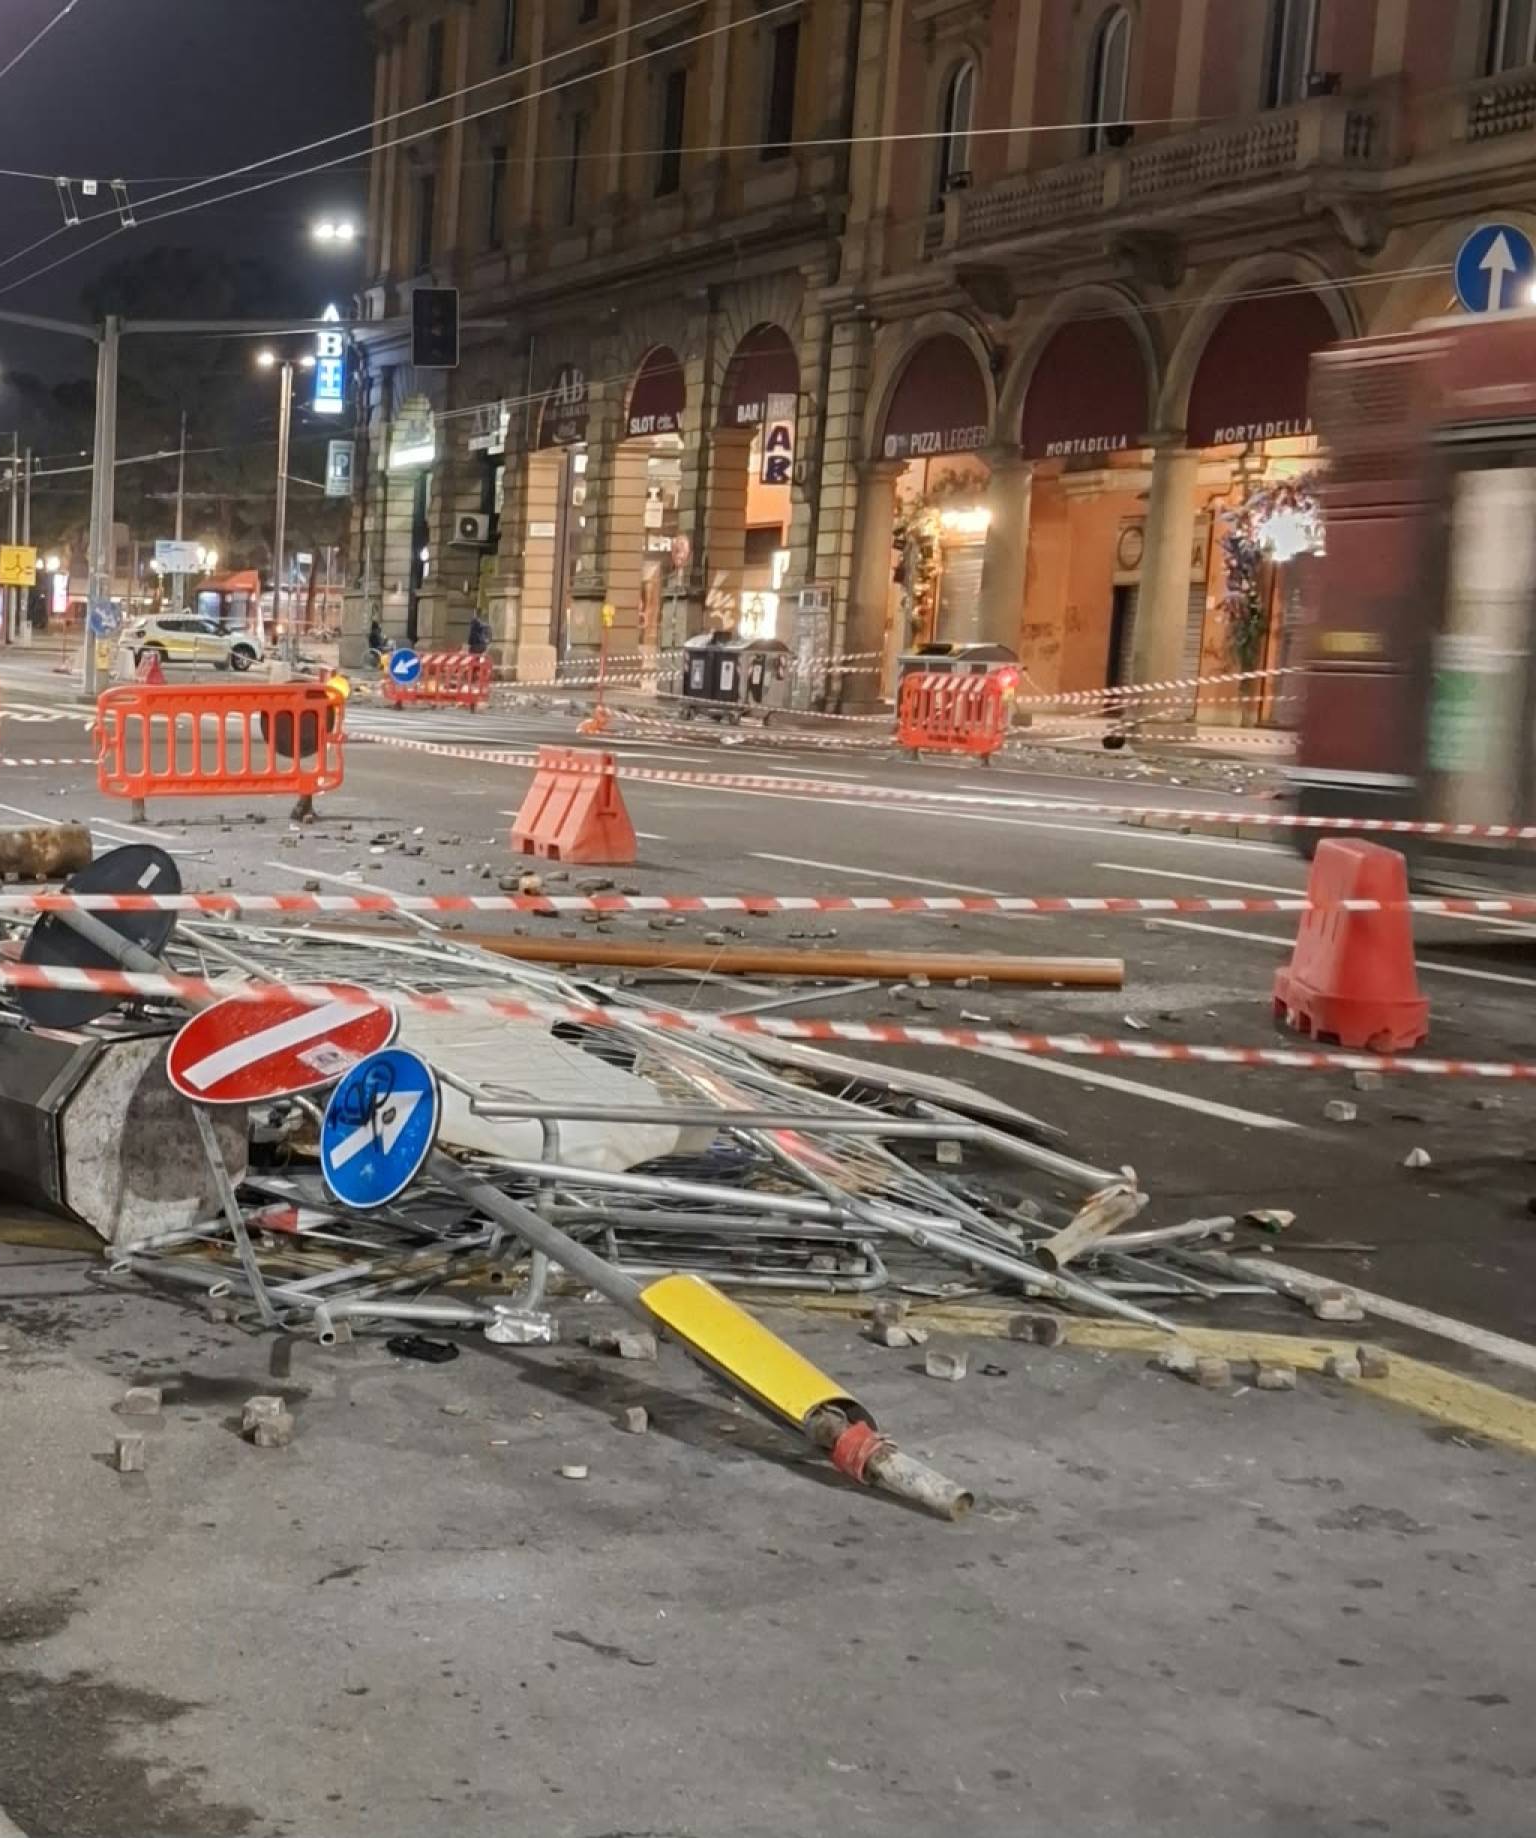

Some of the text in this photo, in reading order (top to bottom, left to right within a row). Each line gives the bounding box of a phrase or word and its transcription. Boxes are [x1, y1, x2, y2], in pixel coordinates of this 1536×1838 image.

[630, 415, 655, 434] SLOT
[737, 403, 759, 423] BAR
[1214, 418, 1313, 443] MORTADELLA
[910, 431, 942, 454] PIZZA
[1046, 434, 1128, 457] MORTADELLA
